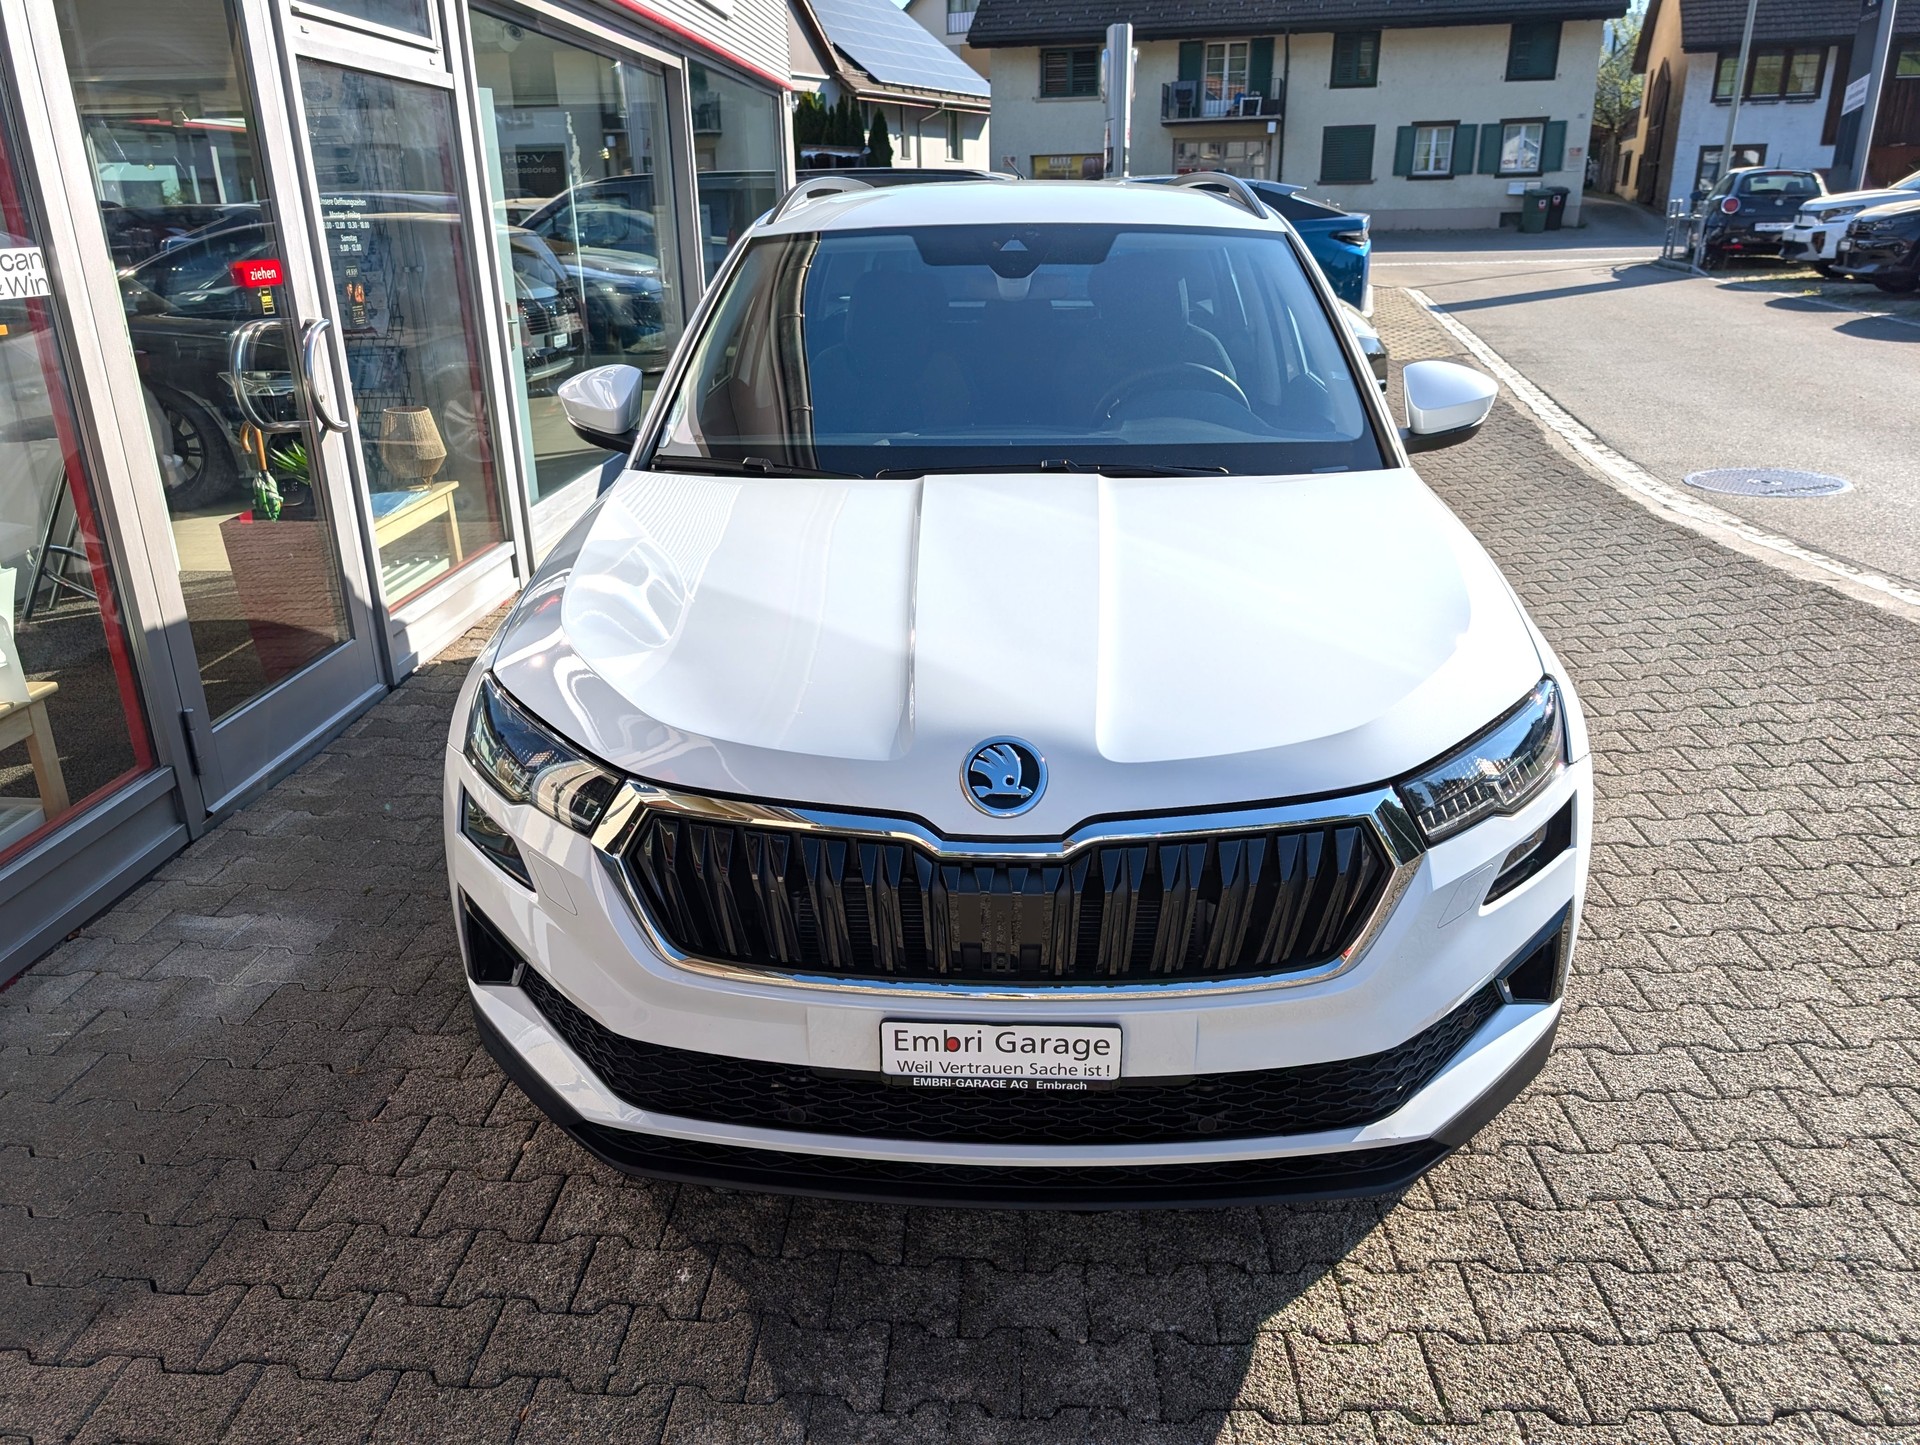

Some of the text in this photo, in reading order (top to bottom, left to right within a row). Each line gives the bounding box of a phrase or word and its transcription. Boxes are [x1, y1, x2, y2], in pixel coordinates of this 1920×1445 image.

[341, 235, 357, 243] Samstag
[250, 266, 277, 281] ziehen
[5, 272, 51, 297] Win
[894, 1029, 1111, 1061] Embri Garage
[897, 1060, 933, 1074] Weil
[938, 1061, 1024, 1075] Vertrauen
[1030, 1062, 1078, 1076] Sache
[913, 1077, 1087, 1091] EMBRI-GARAGE AG Embrach
